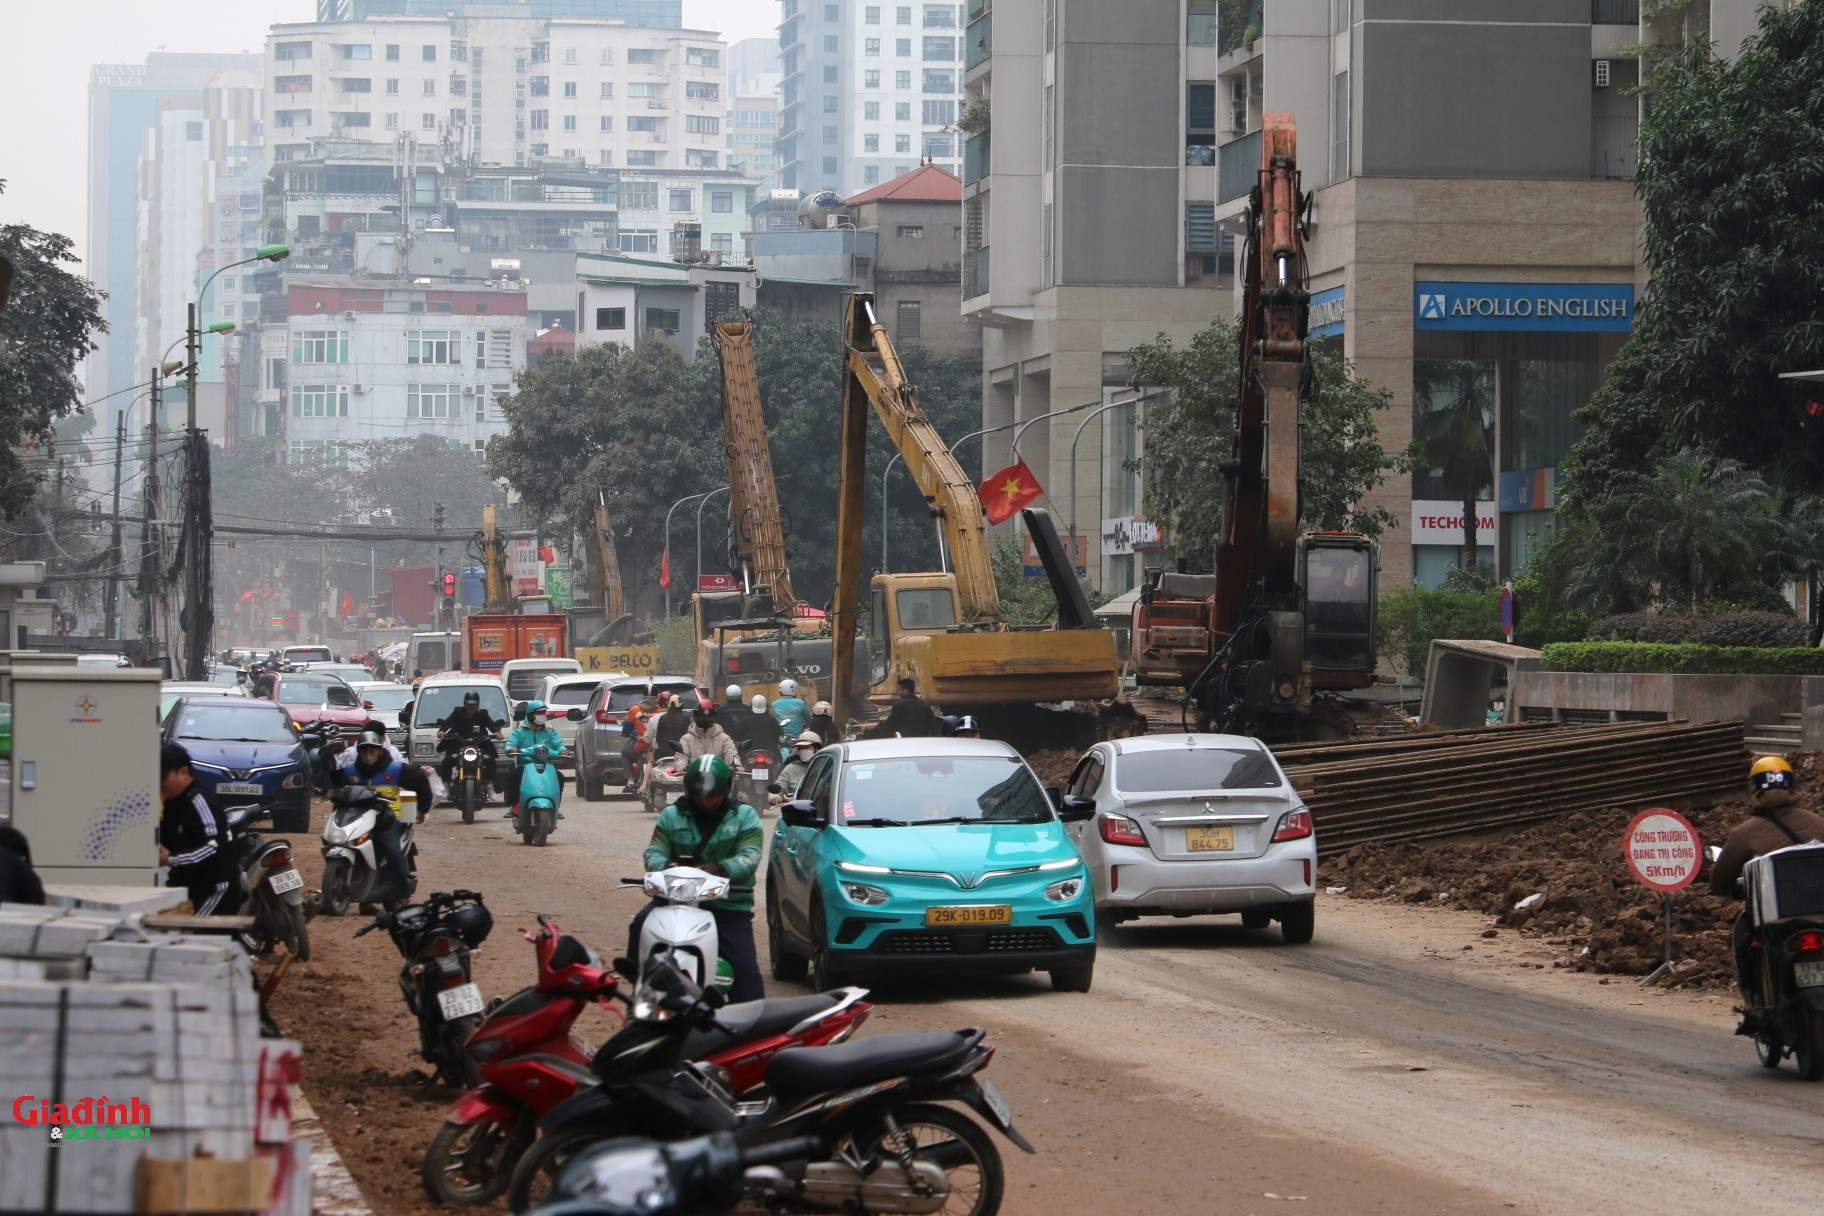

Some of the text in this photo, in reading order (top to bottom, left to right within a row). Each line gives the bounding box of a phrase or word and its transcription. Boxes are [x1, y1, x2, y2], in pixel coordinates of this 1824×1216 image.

[96, 65, 147, 76] GRAND
[98, 76, 143, 87] PLAZA
[1451, 298, 1627, 317] APOLLO ENGLISH
[1766, 772, 1784, 783] be
[1200, 828, 1220, 838] 30H
[1634, 830, 1656, 843] CÔNG
[1191, 838, 1229, 849] 844.75
[1633, 848, 1656, 860] ĐANG
[1671, 846, 1694, 859] CÔNG
[1646, 865, 1686, 878] 5Km/h
[934, 908, 1004, 922] 29K-019.09
